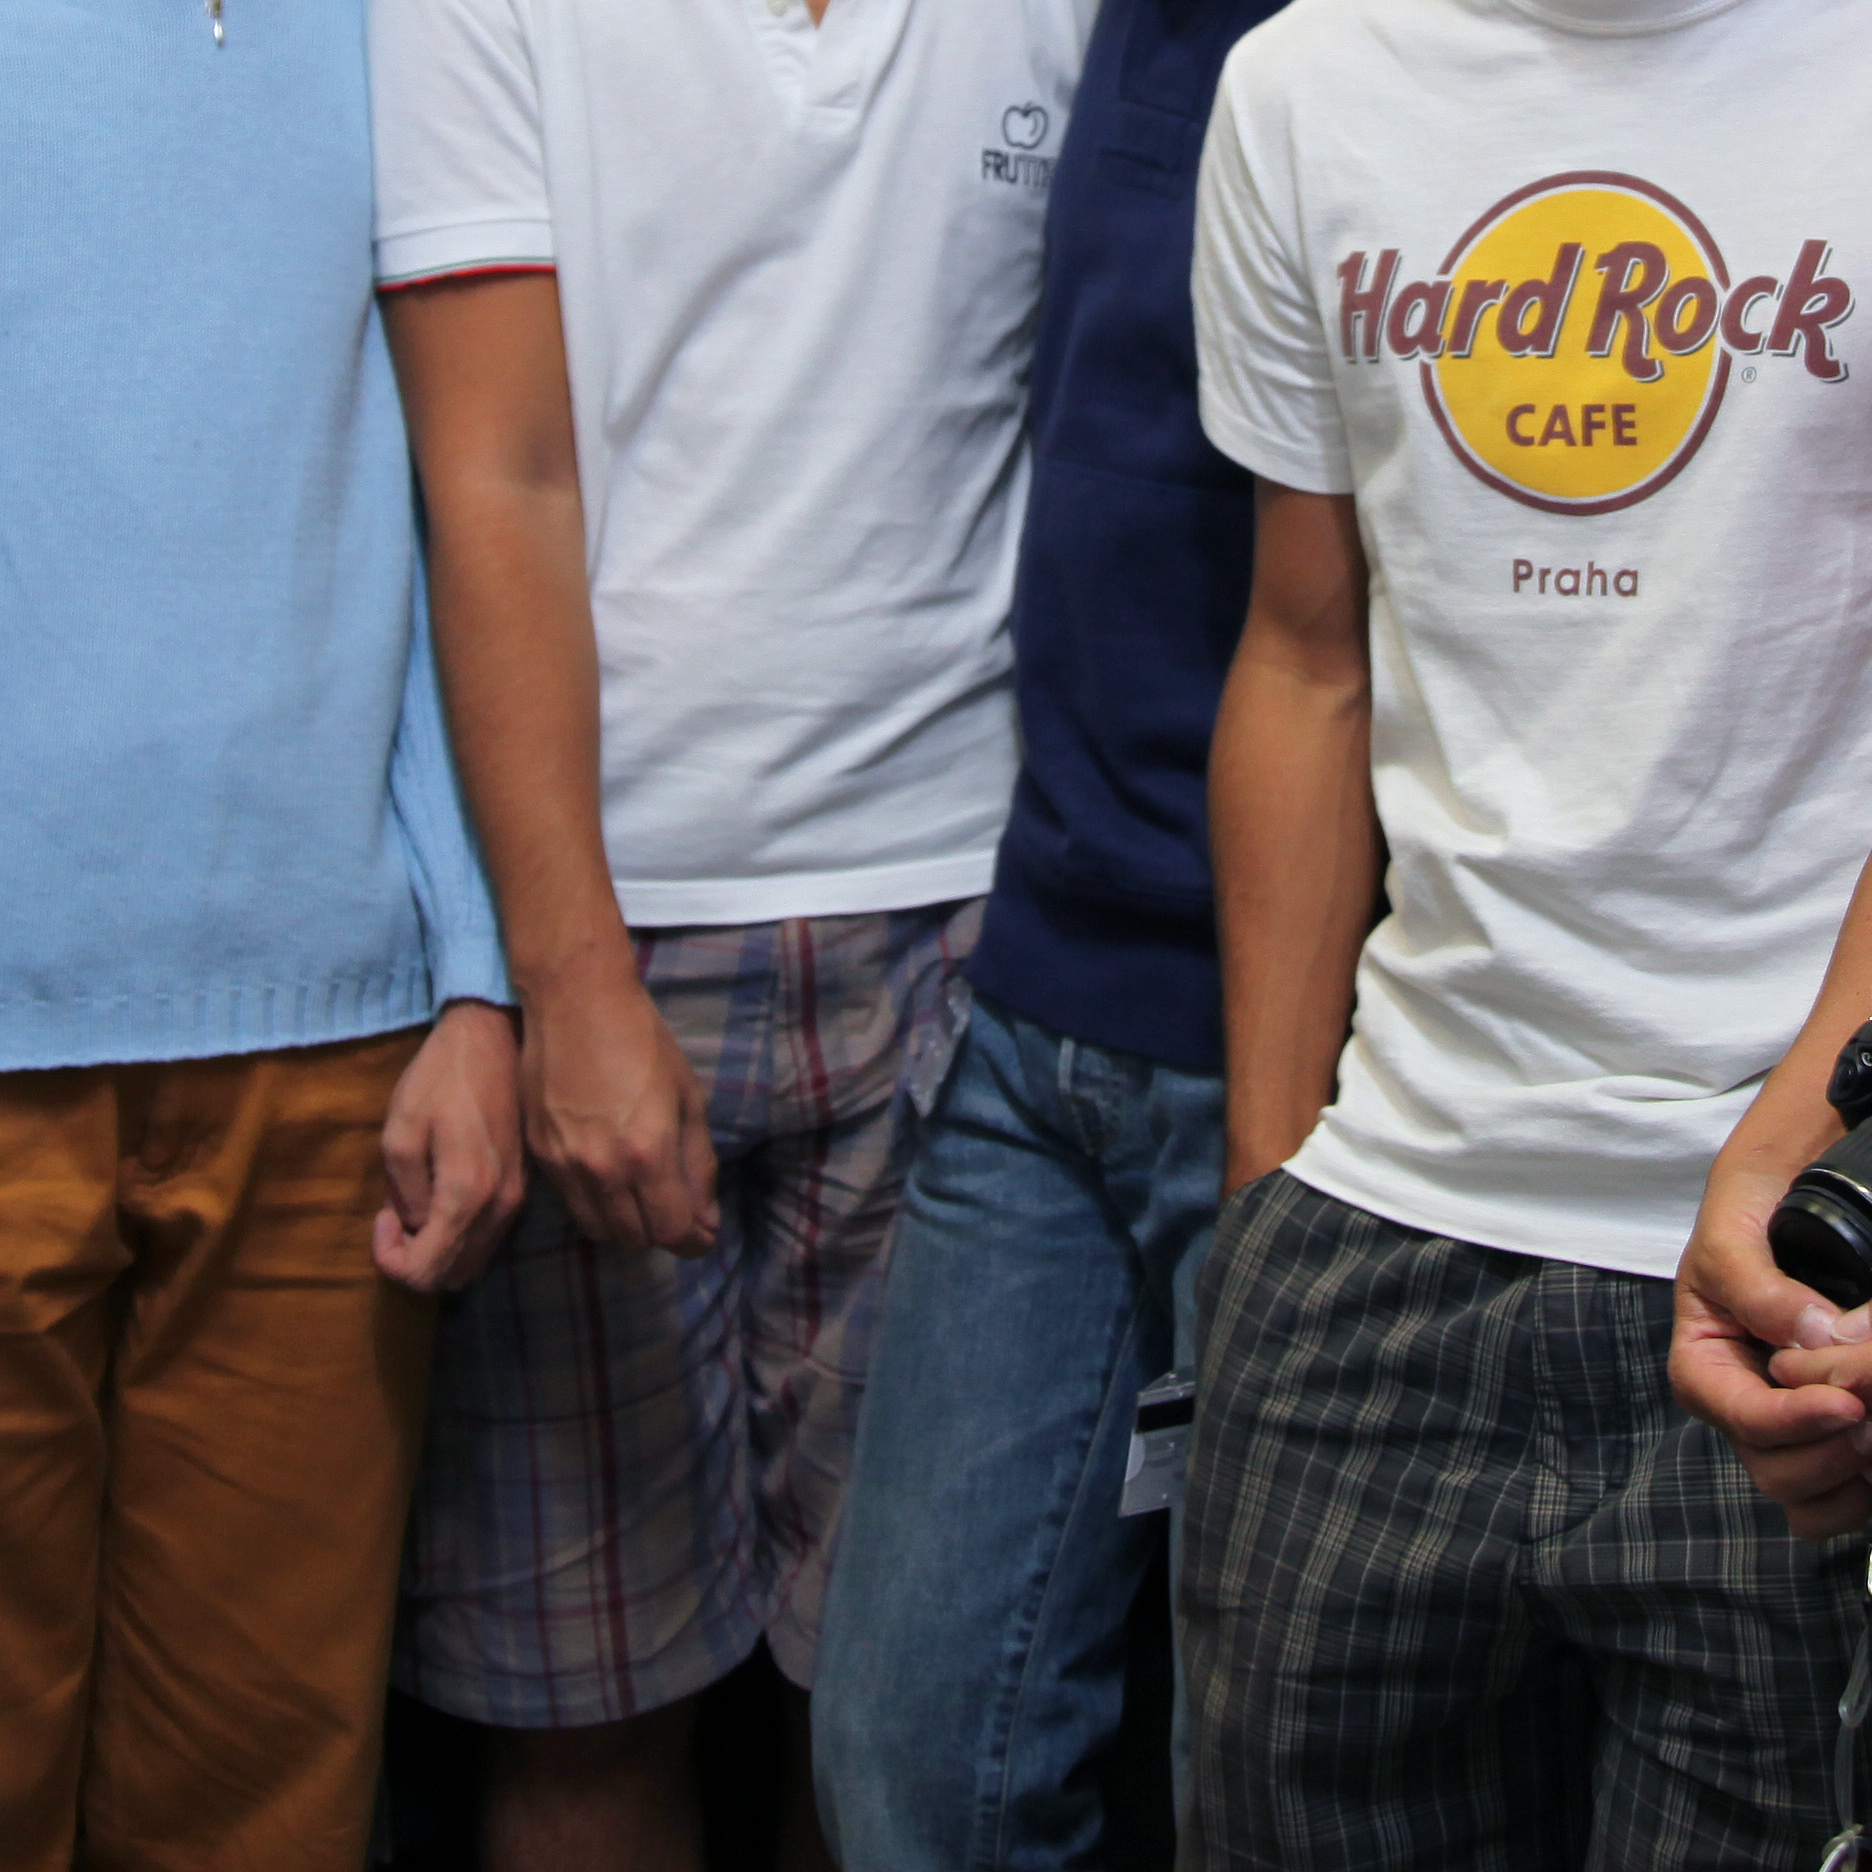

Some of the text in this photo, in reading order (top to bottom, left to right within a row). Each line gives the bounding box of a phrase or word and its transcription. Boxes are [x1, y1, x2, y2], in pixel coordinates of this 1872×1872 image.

[1337, 239, 1856, 383] Hard Rock
[1505, 403, 1638, 447] CAFE
[1512, 559, 1639, 598] Praha
